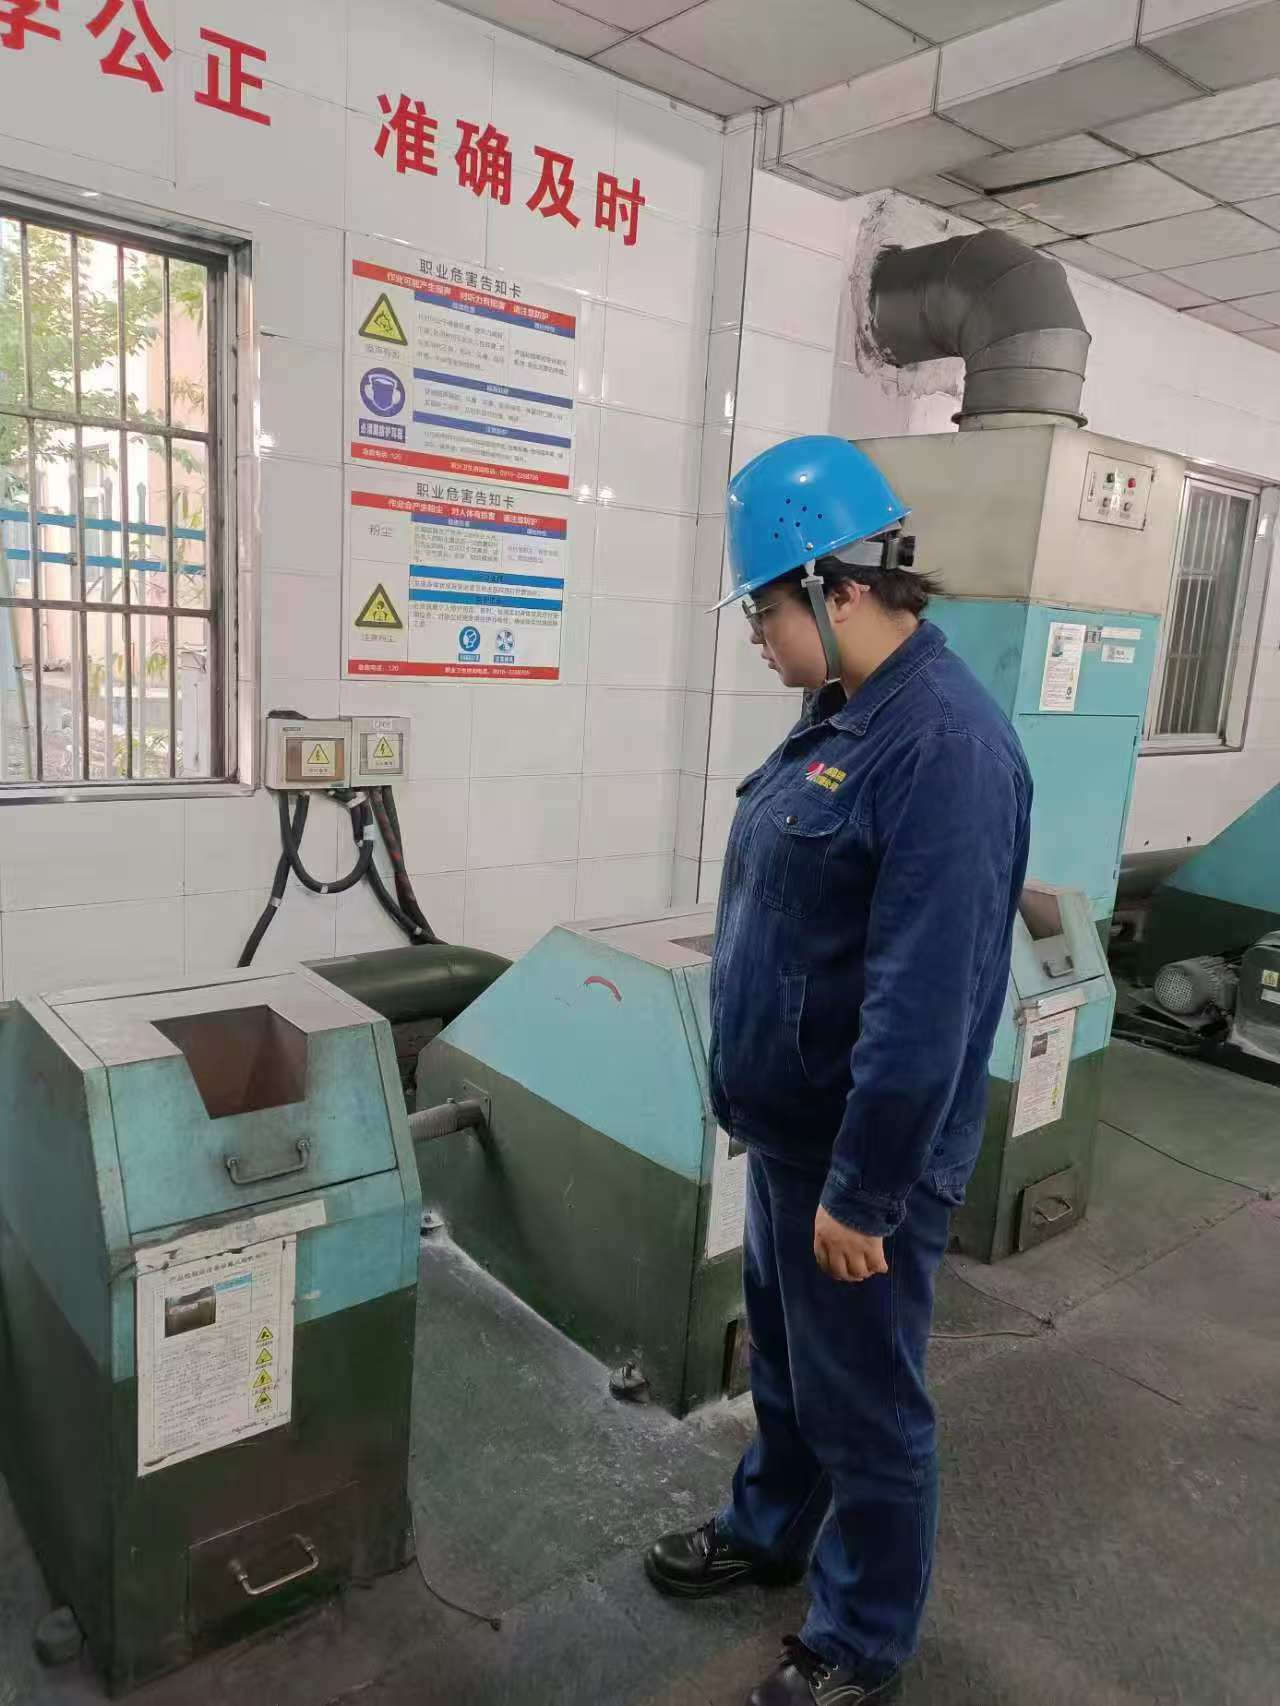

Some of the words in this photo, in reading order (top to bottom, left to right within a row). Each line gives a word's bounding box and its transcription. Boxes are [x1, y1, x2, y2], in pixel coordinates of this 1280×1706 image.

[374, 93, 646, 246] 准确及时
[419, 258, 522, 299] 职业危害告知卡
[416, 482, 516, 509] 职业危害告知卡
[368, 524, 393, 538] 粉尘
